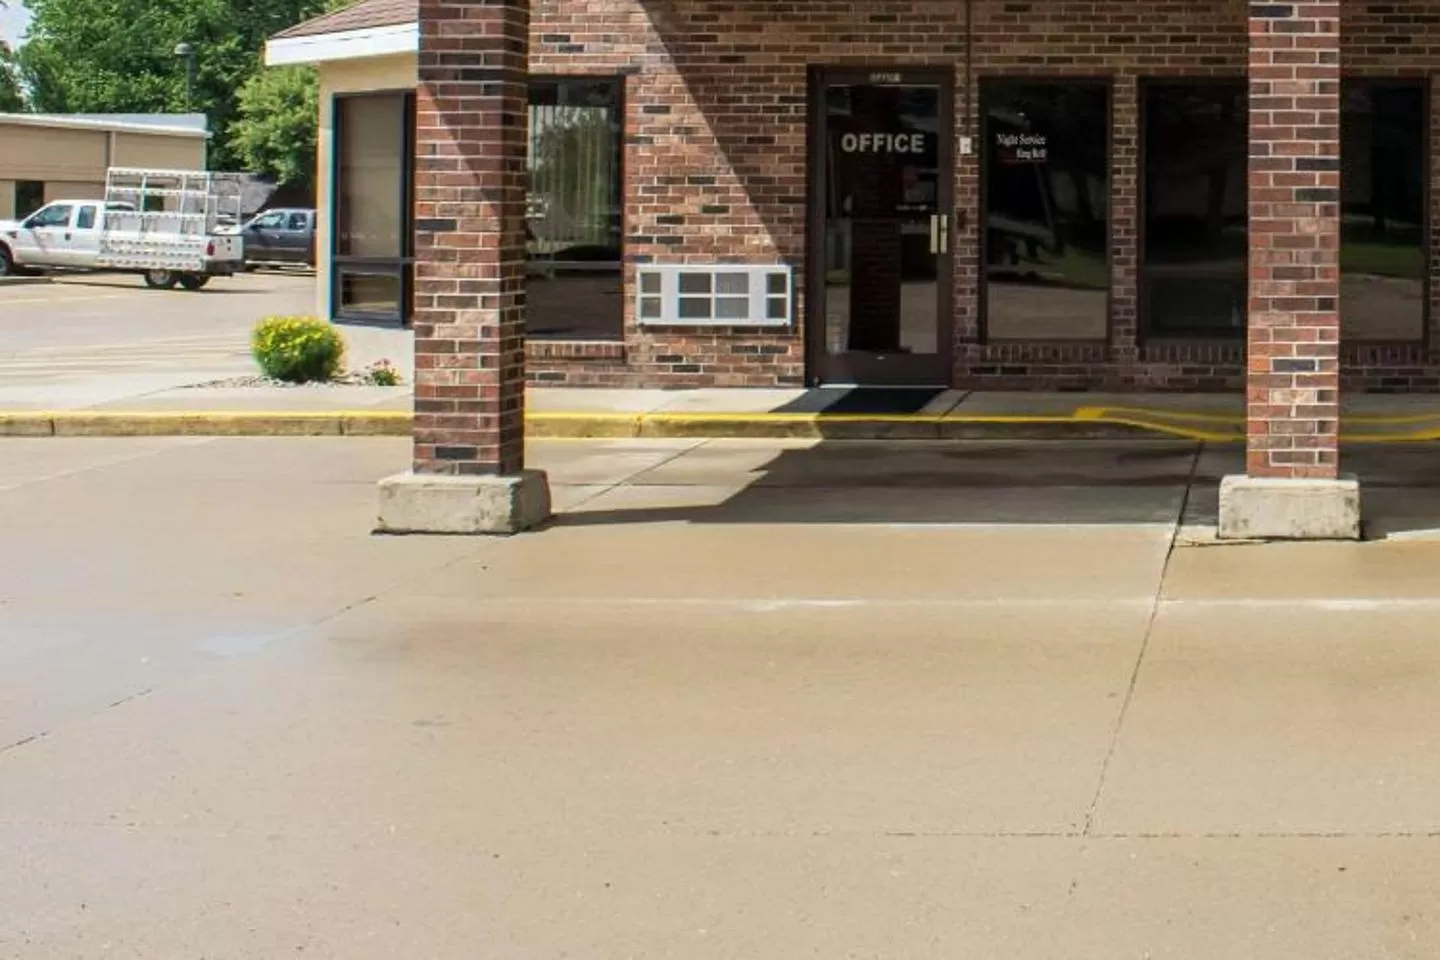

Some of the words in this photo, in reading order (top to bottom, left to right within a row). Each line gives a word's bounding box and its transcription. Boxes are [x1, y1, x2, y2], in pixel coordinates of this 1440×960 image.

[841, 133, 925, 153] OFFICE
[996, 132, 1018, 147] Night
[1019, 132, 1047, 146] Service
